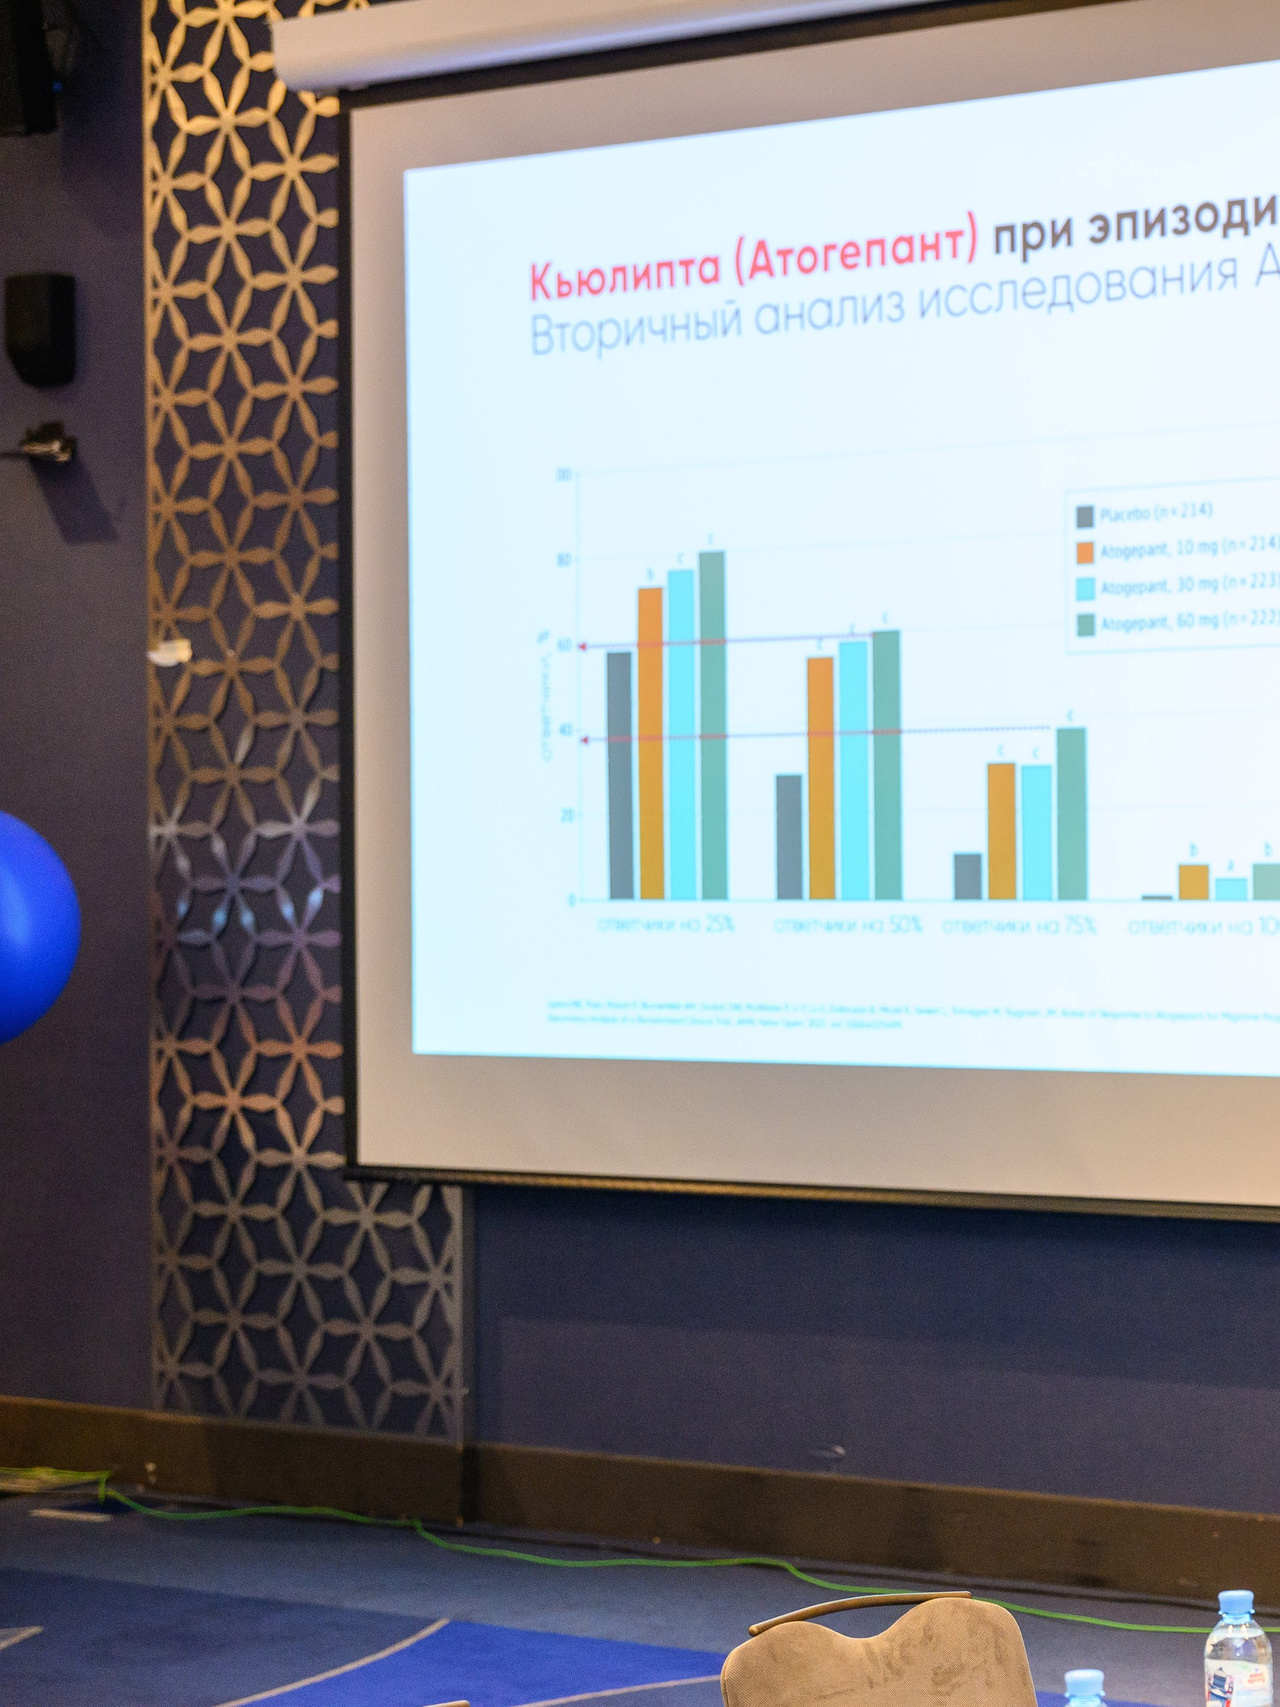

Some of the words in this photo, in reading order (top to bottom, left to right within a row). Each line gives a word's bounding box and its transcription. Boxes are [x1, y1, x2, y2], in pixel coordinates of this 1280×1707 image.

[530, 255, 721, 302] Кьюлипта
[735, 211, 979, 287] (Атогепант)
[993, 216, 1075, 265] при
[531, 302, 742, 360] Вторичный
[754, 289, 906, 336] анализ
[918, 255, 1239, 320] исследования
[1177, 538, 1195, 555] 10
[1198, 539, 1218, 556] mg
[1177, 576, 1195, 593] 30
[1198, 577, 1219, 594] mg
[1177, 612, 1195, 629] 60
[1198, 613, 1219, 631] mg
[705, 913, 736, 934] 25%
[889, 913, 923, 935] 50%
[1064, 914, 1098, 935] 75%
